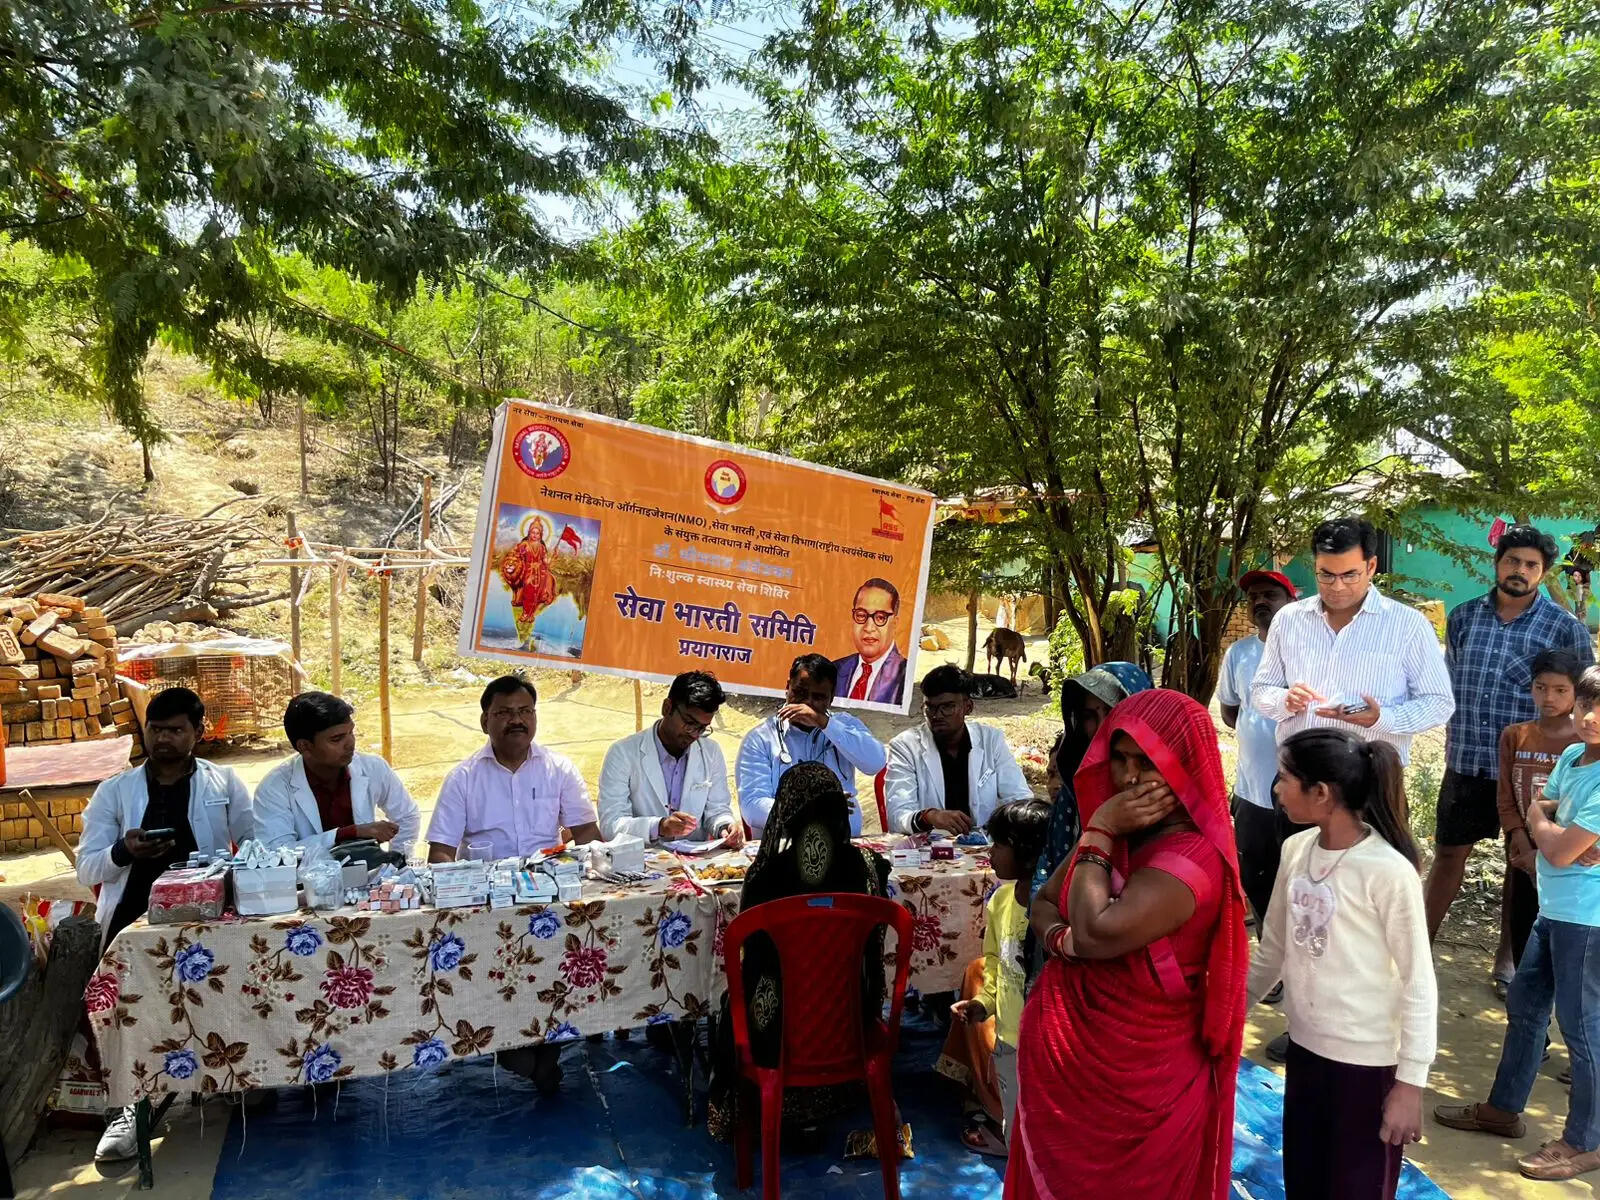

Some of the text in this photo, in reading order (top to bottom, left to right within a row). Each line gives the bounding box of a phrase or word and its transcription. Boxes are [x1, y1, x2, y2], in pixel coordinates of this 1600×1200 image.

[540, 485, 573, 501] नेशनल
[575, 491, 615, 509] मेडिकोज
[616, 501, 707, 528] ऑर्गनाइजेशन(NMO)
[731, 523, 755, 536] भारती
[774, 530, 789, 543] सेवा
[841, 547, 876, 560] स्वयंसेवक
[877, 552, 894, 564] संघ)
[664, 525, 790, 558] के संयुक्त तत्वावधान में आयोजित
[697, 573, 734, 590] स्वास्थ्य
[736, 579, 757, 595] सेवा
[760, 582, 790, 600] शिविर
[614, 585, 818, 645] सेवा भारती समिति
[678, 639, 753, 664] प्रयागराज
